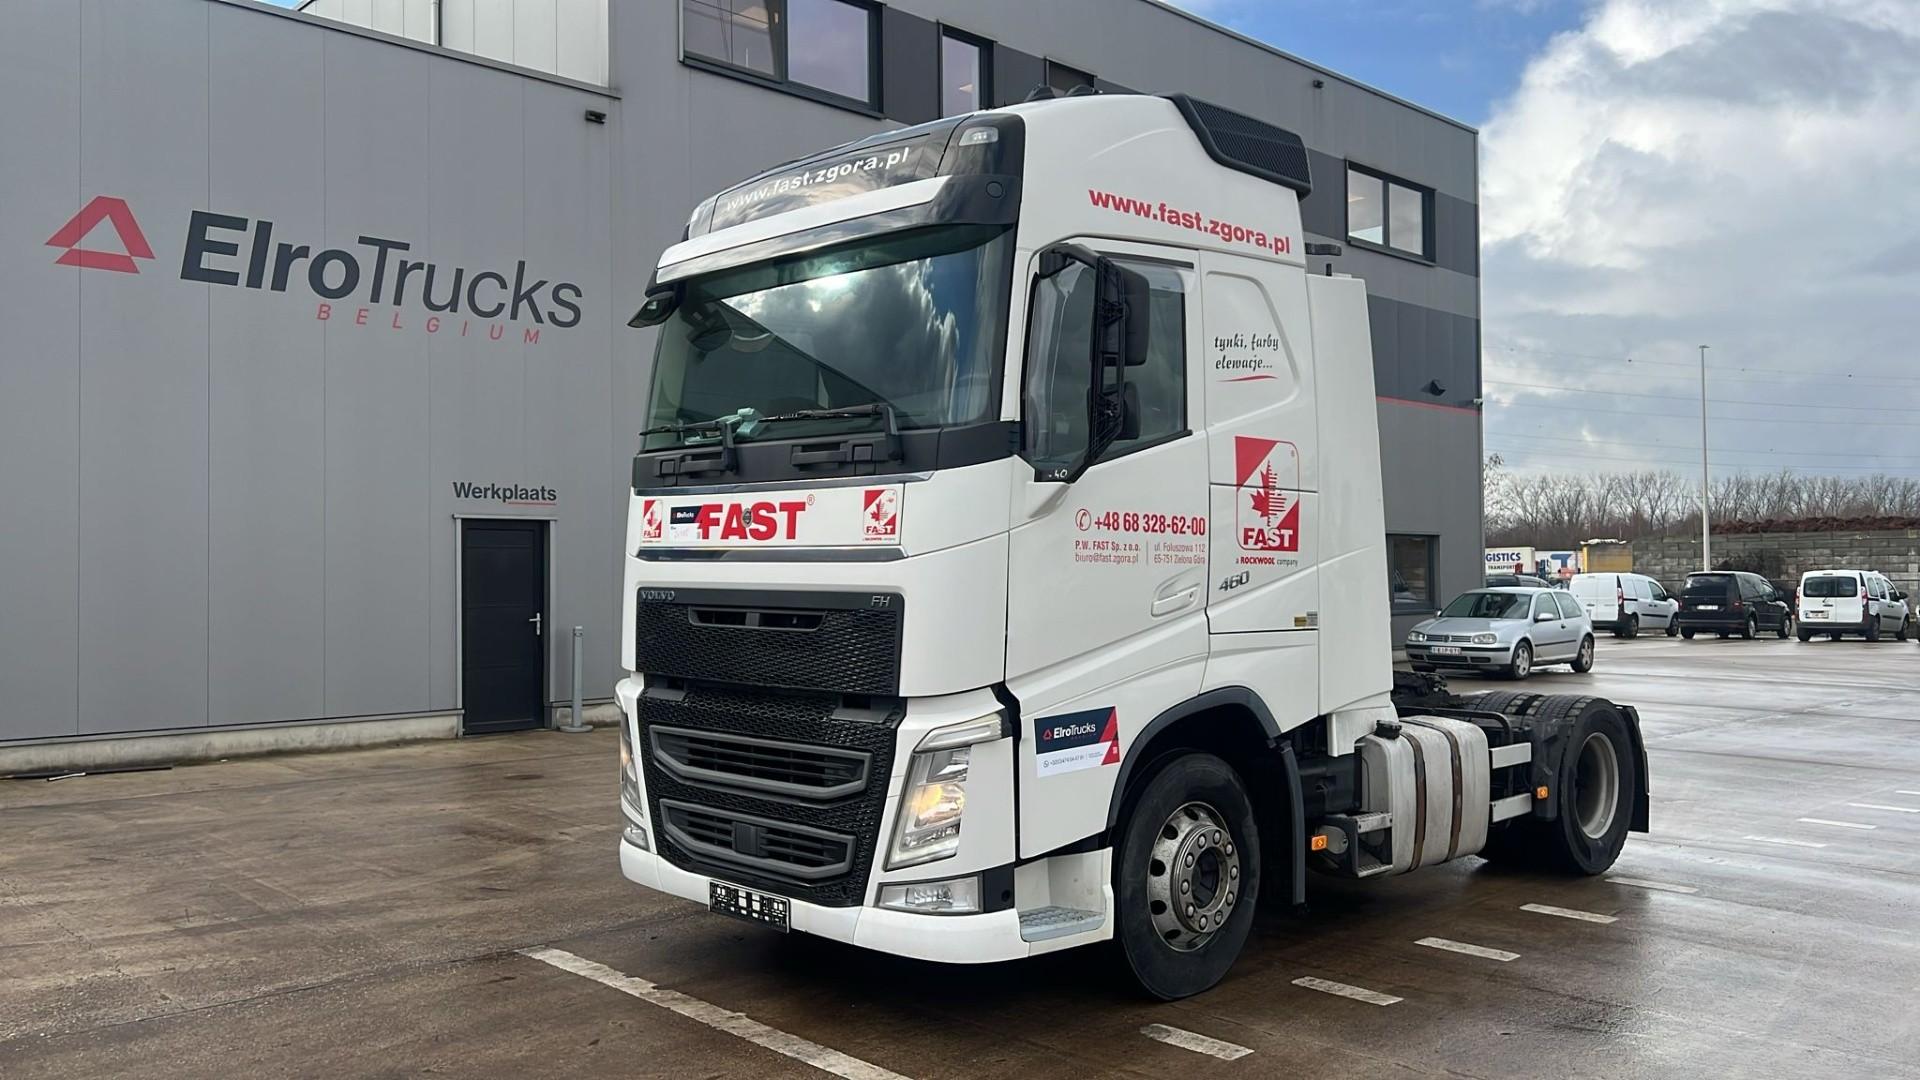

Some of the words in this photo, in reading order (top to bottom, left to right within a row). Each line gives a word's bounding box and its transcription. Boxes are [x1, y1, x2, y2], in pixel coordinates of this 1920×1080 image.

[727, 147, 910, 211] www.fast.zgora.pl
[1089, 189, 1290, 254] www.fast.zgora.pl
[180, 210, 583, 328] ElroTrucks
[317, 303, 541, 345] BELGIUM
[1214, 333, 1247, 351] tynki,
[1251, 333, 1279, 351] farby
[453, 482, 557, 503] Werkplaats
[701, 501, 806, 540] FAST
[866, 525, 894, 534] FAST
[1094, 512, 1120, 531] +48
[1123, 512, 1139, 532] 68
[1142, 514, 1206, 536] 328-62-00
[1093, 541, 1109, 550] FAST
[1243, 527, 1293, 548] FAST
[1240, 556, 1275, 565] ROCKWOOL
[1218, 570, 1249, 591] 460
[642, 590, 675, 600] VOLVO
[871, 595, 890, 607] FH
[1053, 722, 1096, 739] ElroTrucks
